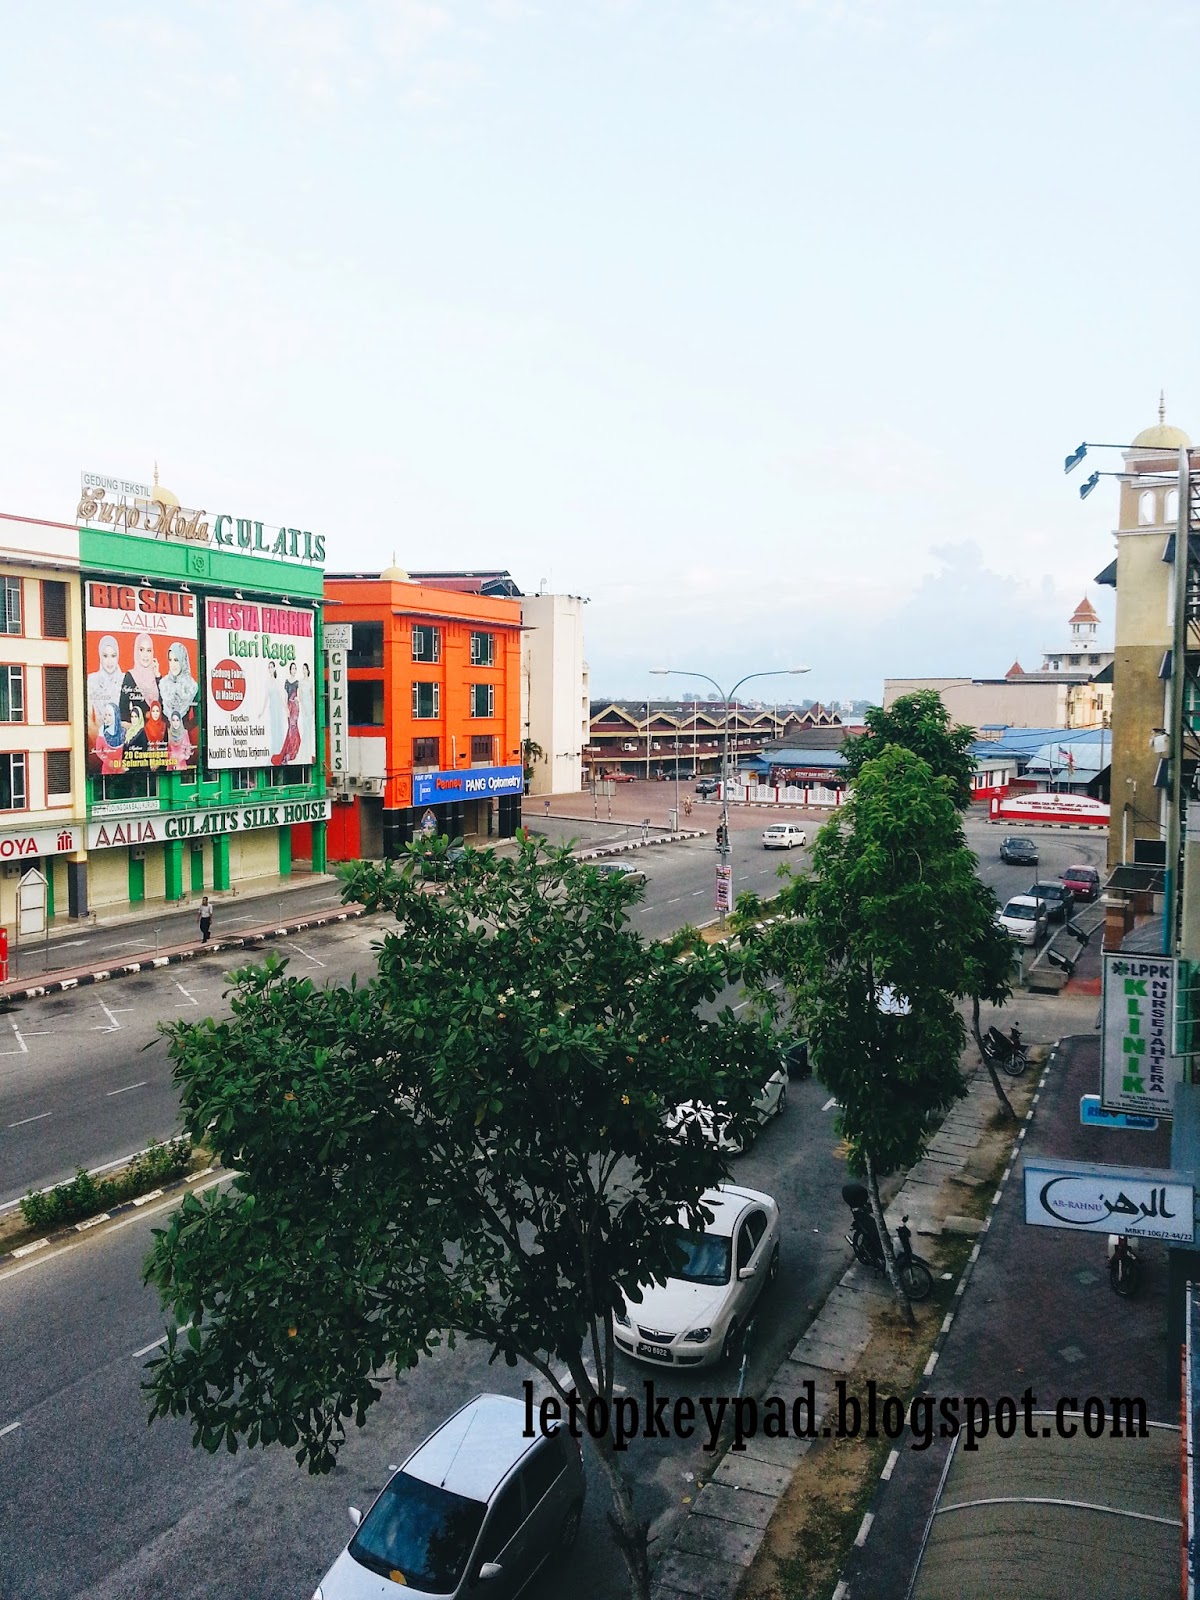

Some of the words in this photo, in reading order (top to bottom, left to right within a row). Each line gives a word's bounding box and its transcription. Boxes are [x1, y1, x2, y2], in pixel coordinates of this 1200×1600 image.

[84, 474, 118, 490] GEDUNG
[120, 481, 151, 497] TEKSTIL
[77, 487, 140, 528] Euro
[144, 500, 209, 541] Moda
[215, 515, 326, 562] GULATIS
[89, 583, 136, 611] BIG
[138, 589, 194, 618] SALE
[207, 600, 260, 632] FIESTA
[261, 607, 313, 638] FABRIK
[228, 631, 259, 658] Hari
[261, 634, 296, 667] Raya
[222, 690, 243, 701] Malaysia
[331, 652, 343, 770] GULATIS
[213, 725, 230, 736] Fabrik
[231, 725, 248, 736] Koleksi
[249, 725, 265, 736] Terkini
[124, 751, 134, 760] 20
[465, 779, 486, 792] PANG
[488, 775, 521, 791] Optometry
[95, 820, 156, 847] AALIA
[165, 811, 239, 838] GULATI'S
[243, 807, 279, 829] SILK
[283, 801, 327, 823] HOUSE
[0, 838, 38, 857] OYA
[1131, 963, 1170, 979] LPPK
[1122, 978, 1148, 1094] KLINIK
[1052, 1199, 1102, 1212] AR-RAHNU
[1124, 1227, 1146, 1235] MBKT
